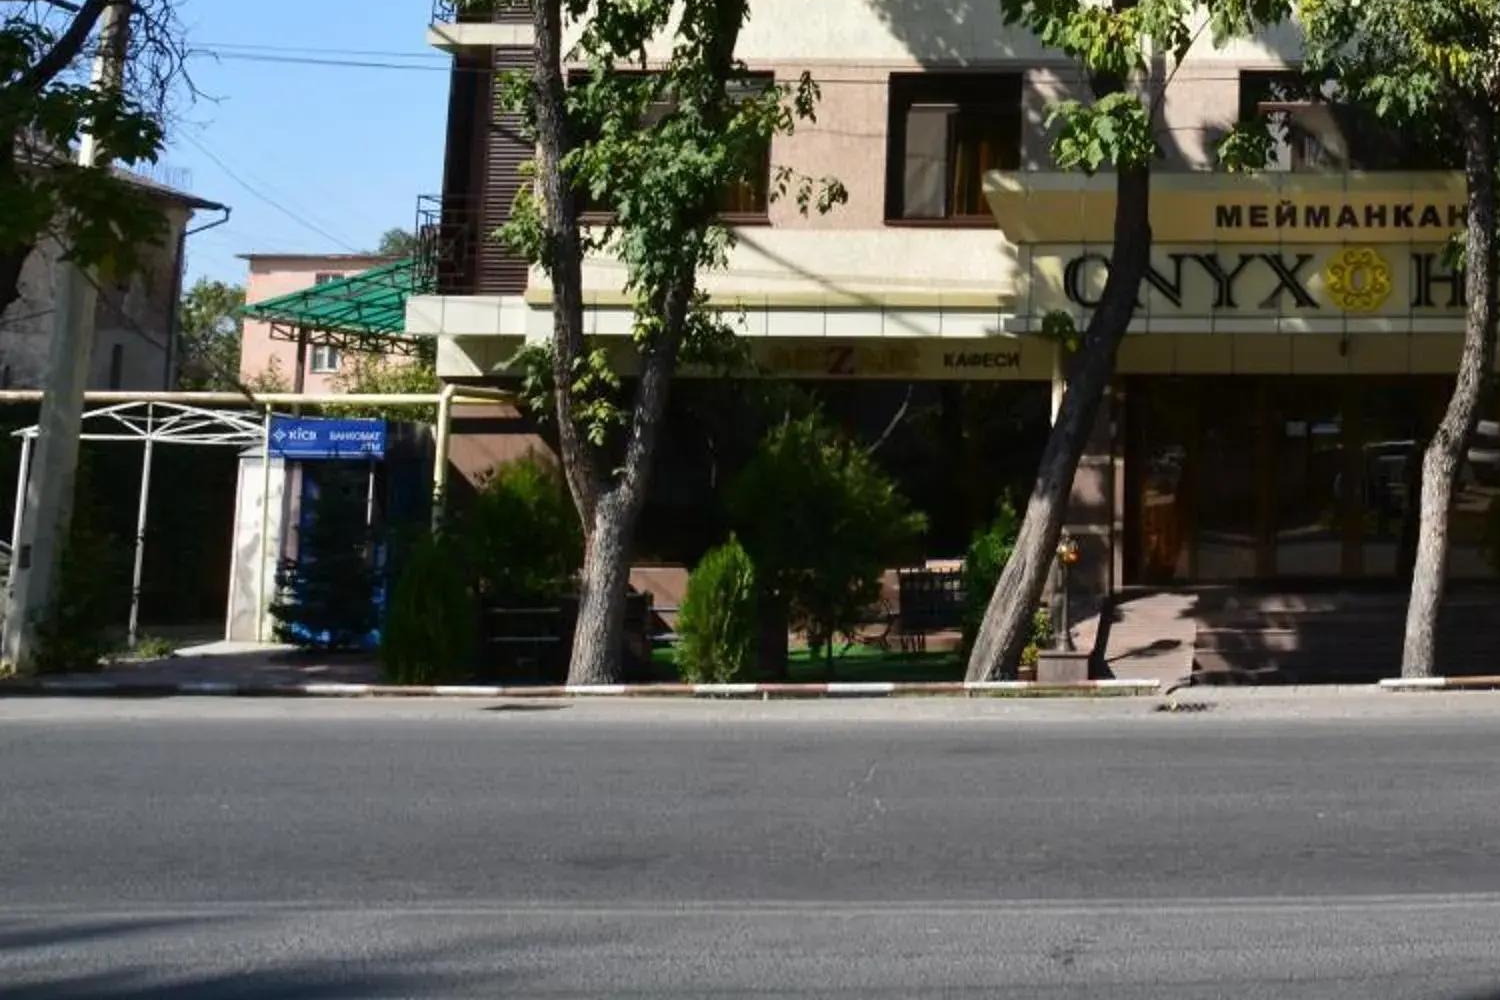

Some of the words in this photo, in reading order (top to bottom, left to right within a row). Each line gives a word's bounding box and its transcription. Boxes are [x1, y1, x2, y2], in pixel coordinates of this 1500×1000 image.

[1215, 200, 1468, 228] МЕЙМАНКАН
[1063, 251, 1320, 309] ONYX
[943, 352, 1020, 369] КАФЕСИ
